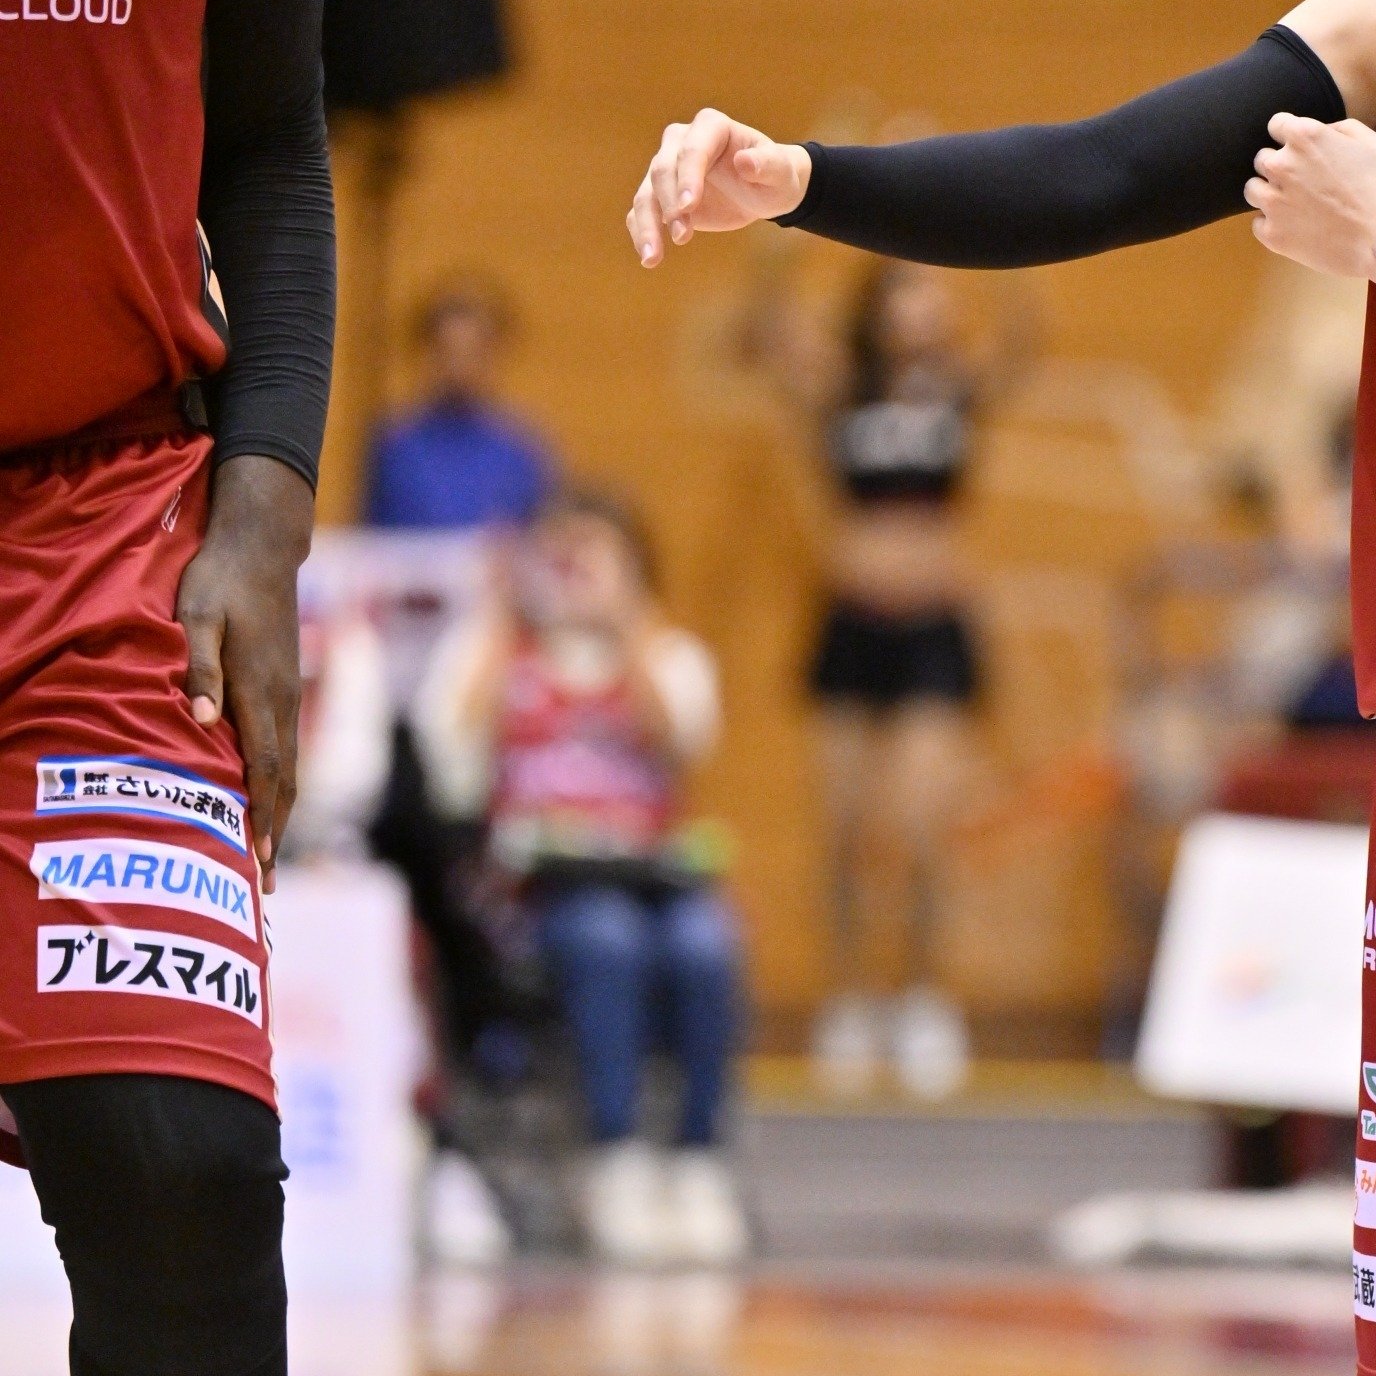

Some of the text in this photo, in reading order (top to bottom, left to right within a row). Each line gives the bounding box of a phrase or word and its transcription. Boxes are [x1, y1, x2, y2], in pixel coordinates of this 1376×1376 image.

[116, 775, 241, 836] さいたま資材
[41, 853, 248, 922] MARUNIX
